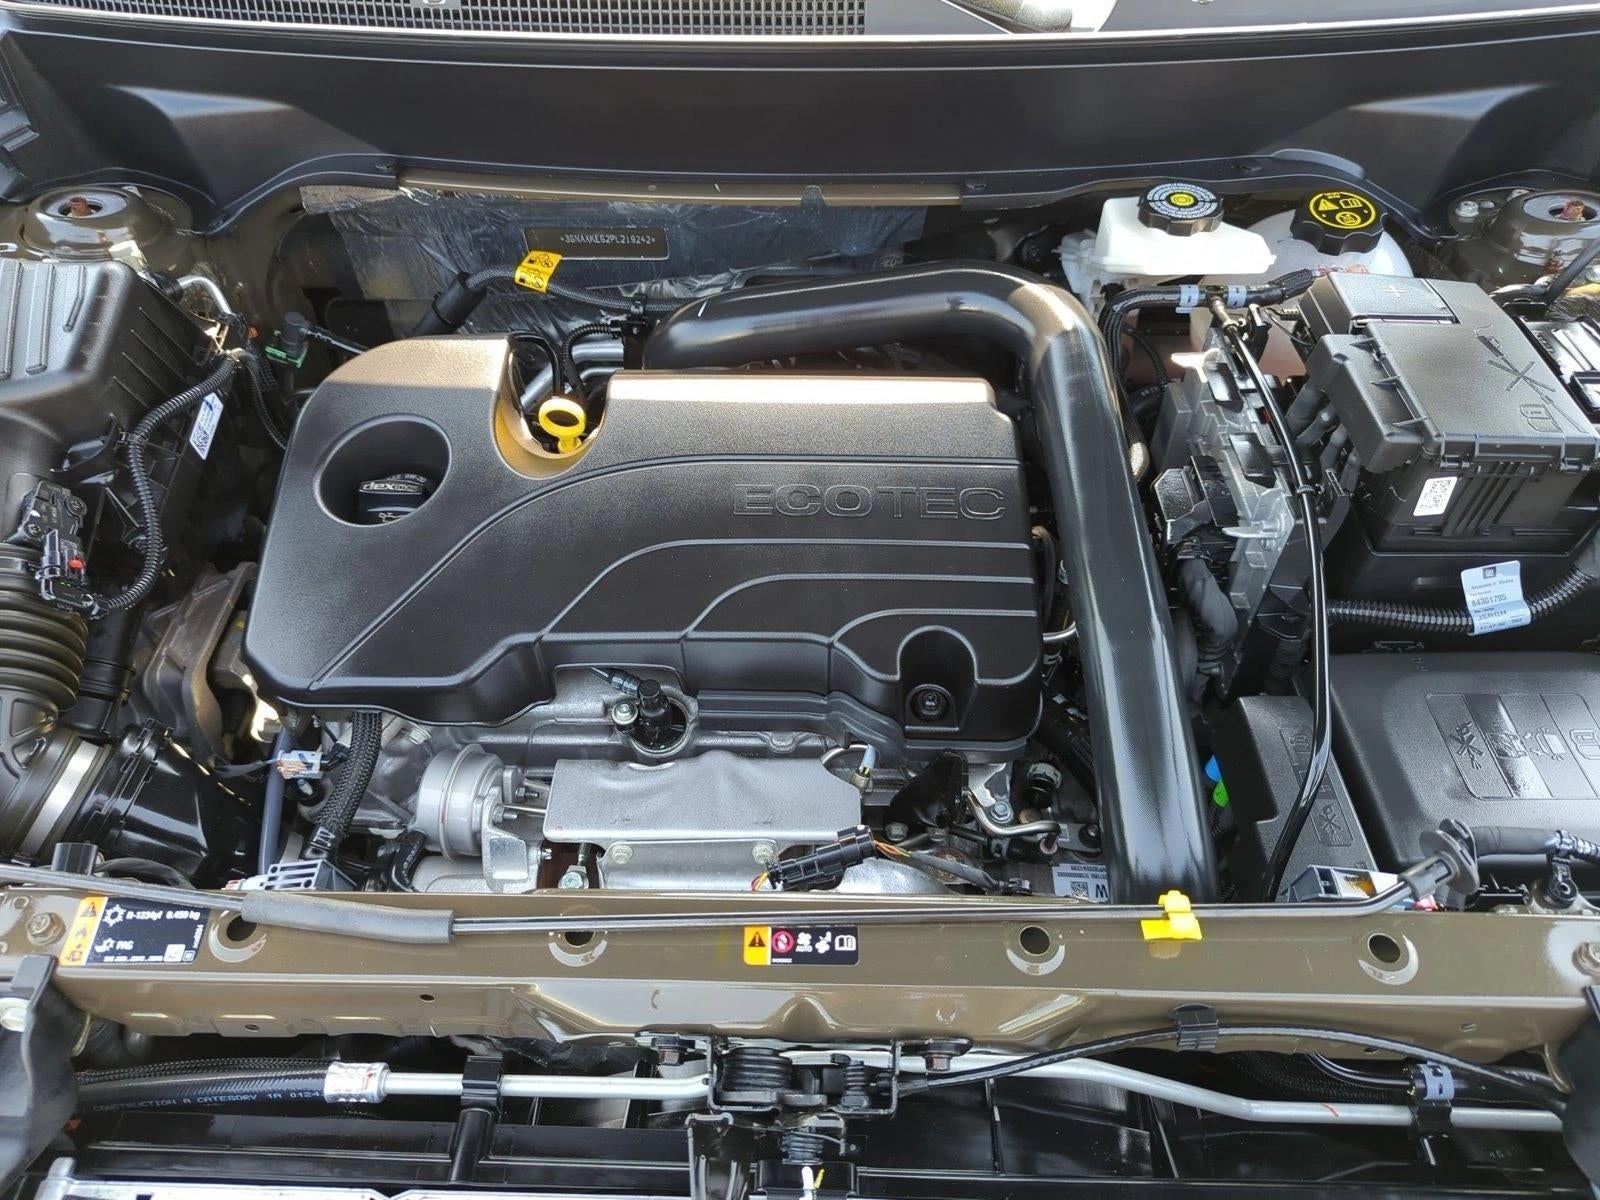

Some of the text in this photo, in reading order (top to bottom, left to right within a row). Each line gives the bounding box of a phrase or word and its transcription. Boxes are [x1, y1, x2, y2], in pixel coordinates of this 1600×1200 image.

[733, 483, 1006, 520] ECOTEC
[116, 940, 134, 950] PAG
[197, 1093, 258, 1104] CATEGORY
